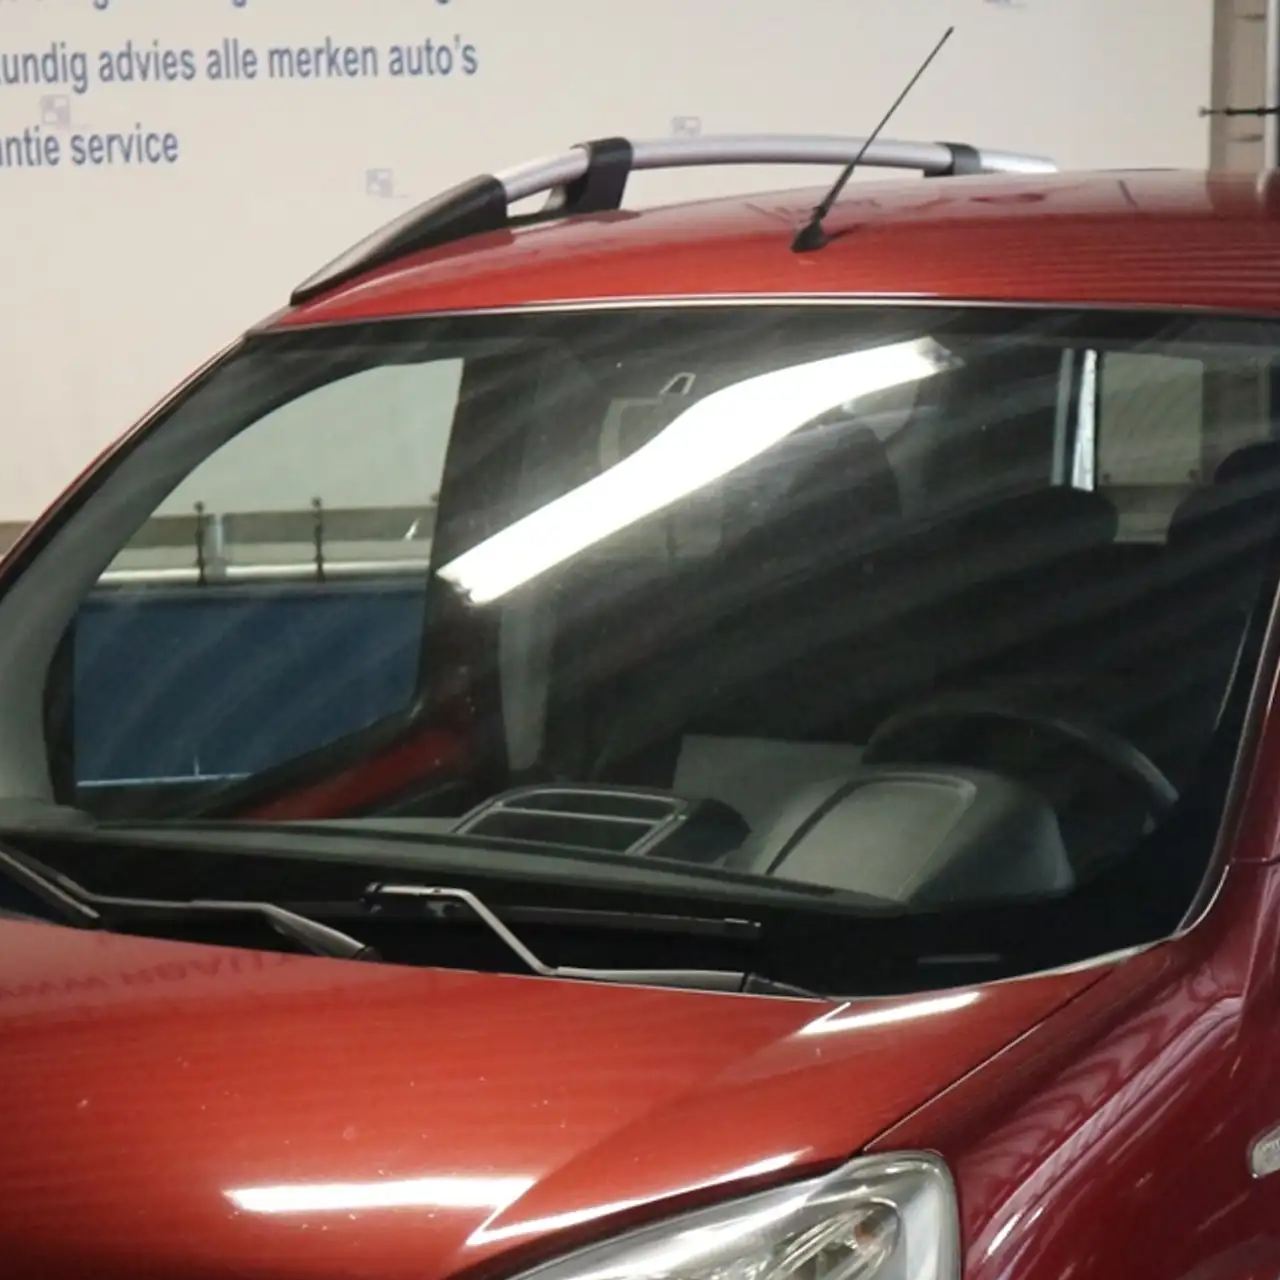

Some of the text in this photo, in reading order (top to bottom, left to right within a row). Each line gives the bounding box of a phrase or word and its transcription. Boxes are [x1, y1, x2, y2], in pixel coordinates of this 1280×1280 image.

[98, 39, 196, 83] advies
[206, 37, 258, 80] alle
[268, 35, 379, 79] merken
[388, 33, 479, 77] auto's
[70, 122, 179, 166] service
